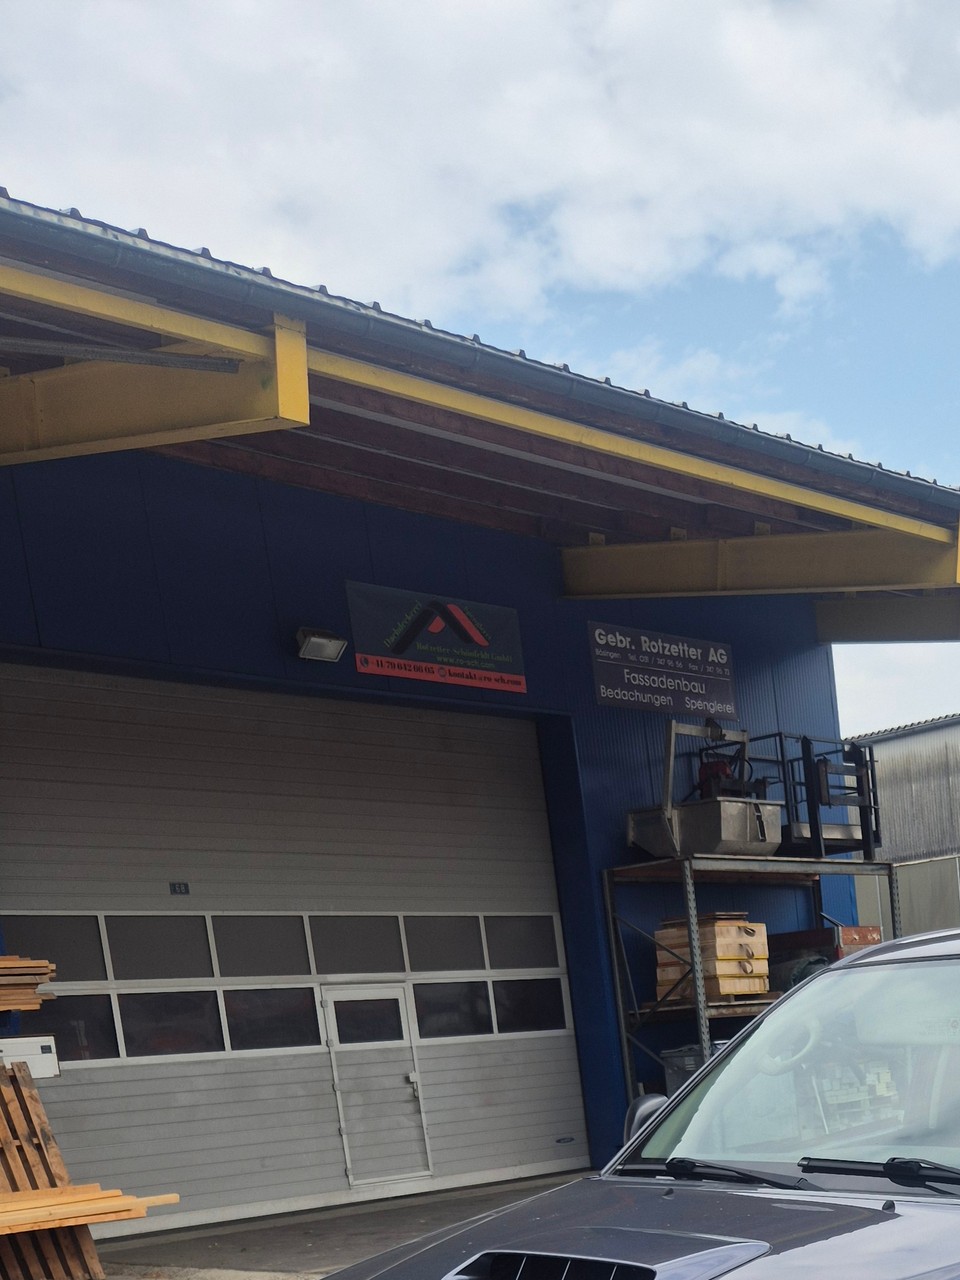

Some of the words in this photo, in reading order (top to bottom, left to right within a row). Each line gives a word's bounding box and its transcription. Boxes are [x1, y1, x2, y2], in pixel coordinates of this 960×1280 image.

[595, 628, 635, 650] Gebr.
[640, 635, 702, 659] Rotzetter
[708, 647, 728, 664] AG
[623, 669, 706, 694] Fassadenbau
[600, 685, 673, 706] Bedachungen
[685, 697, 735, 714] Spenglerei
